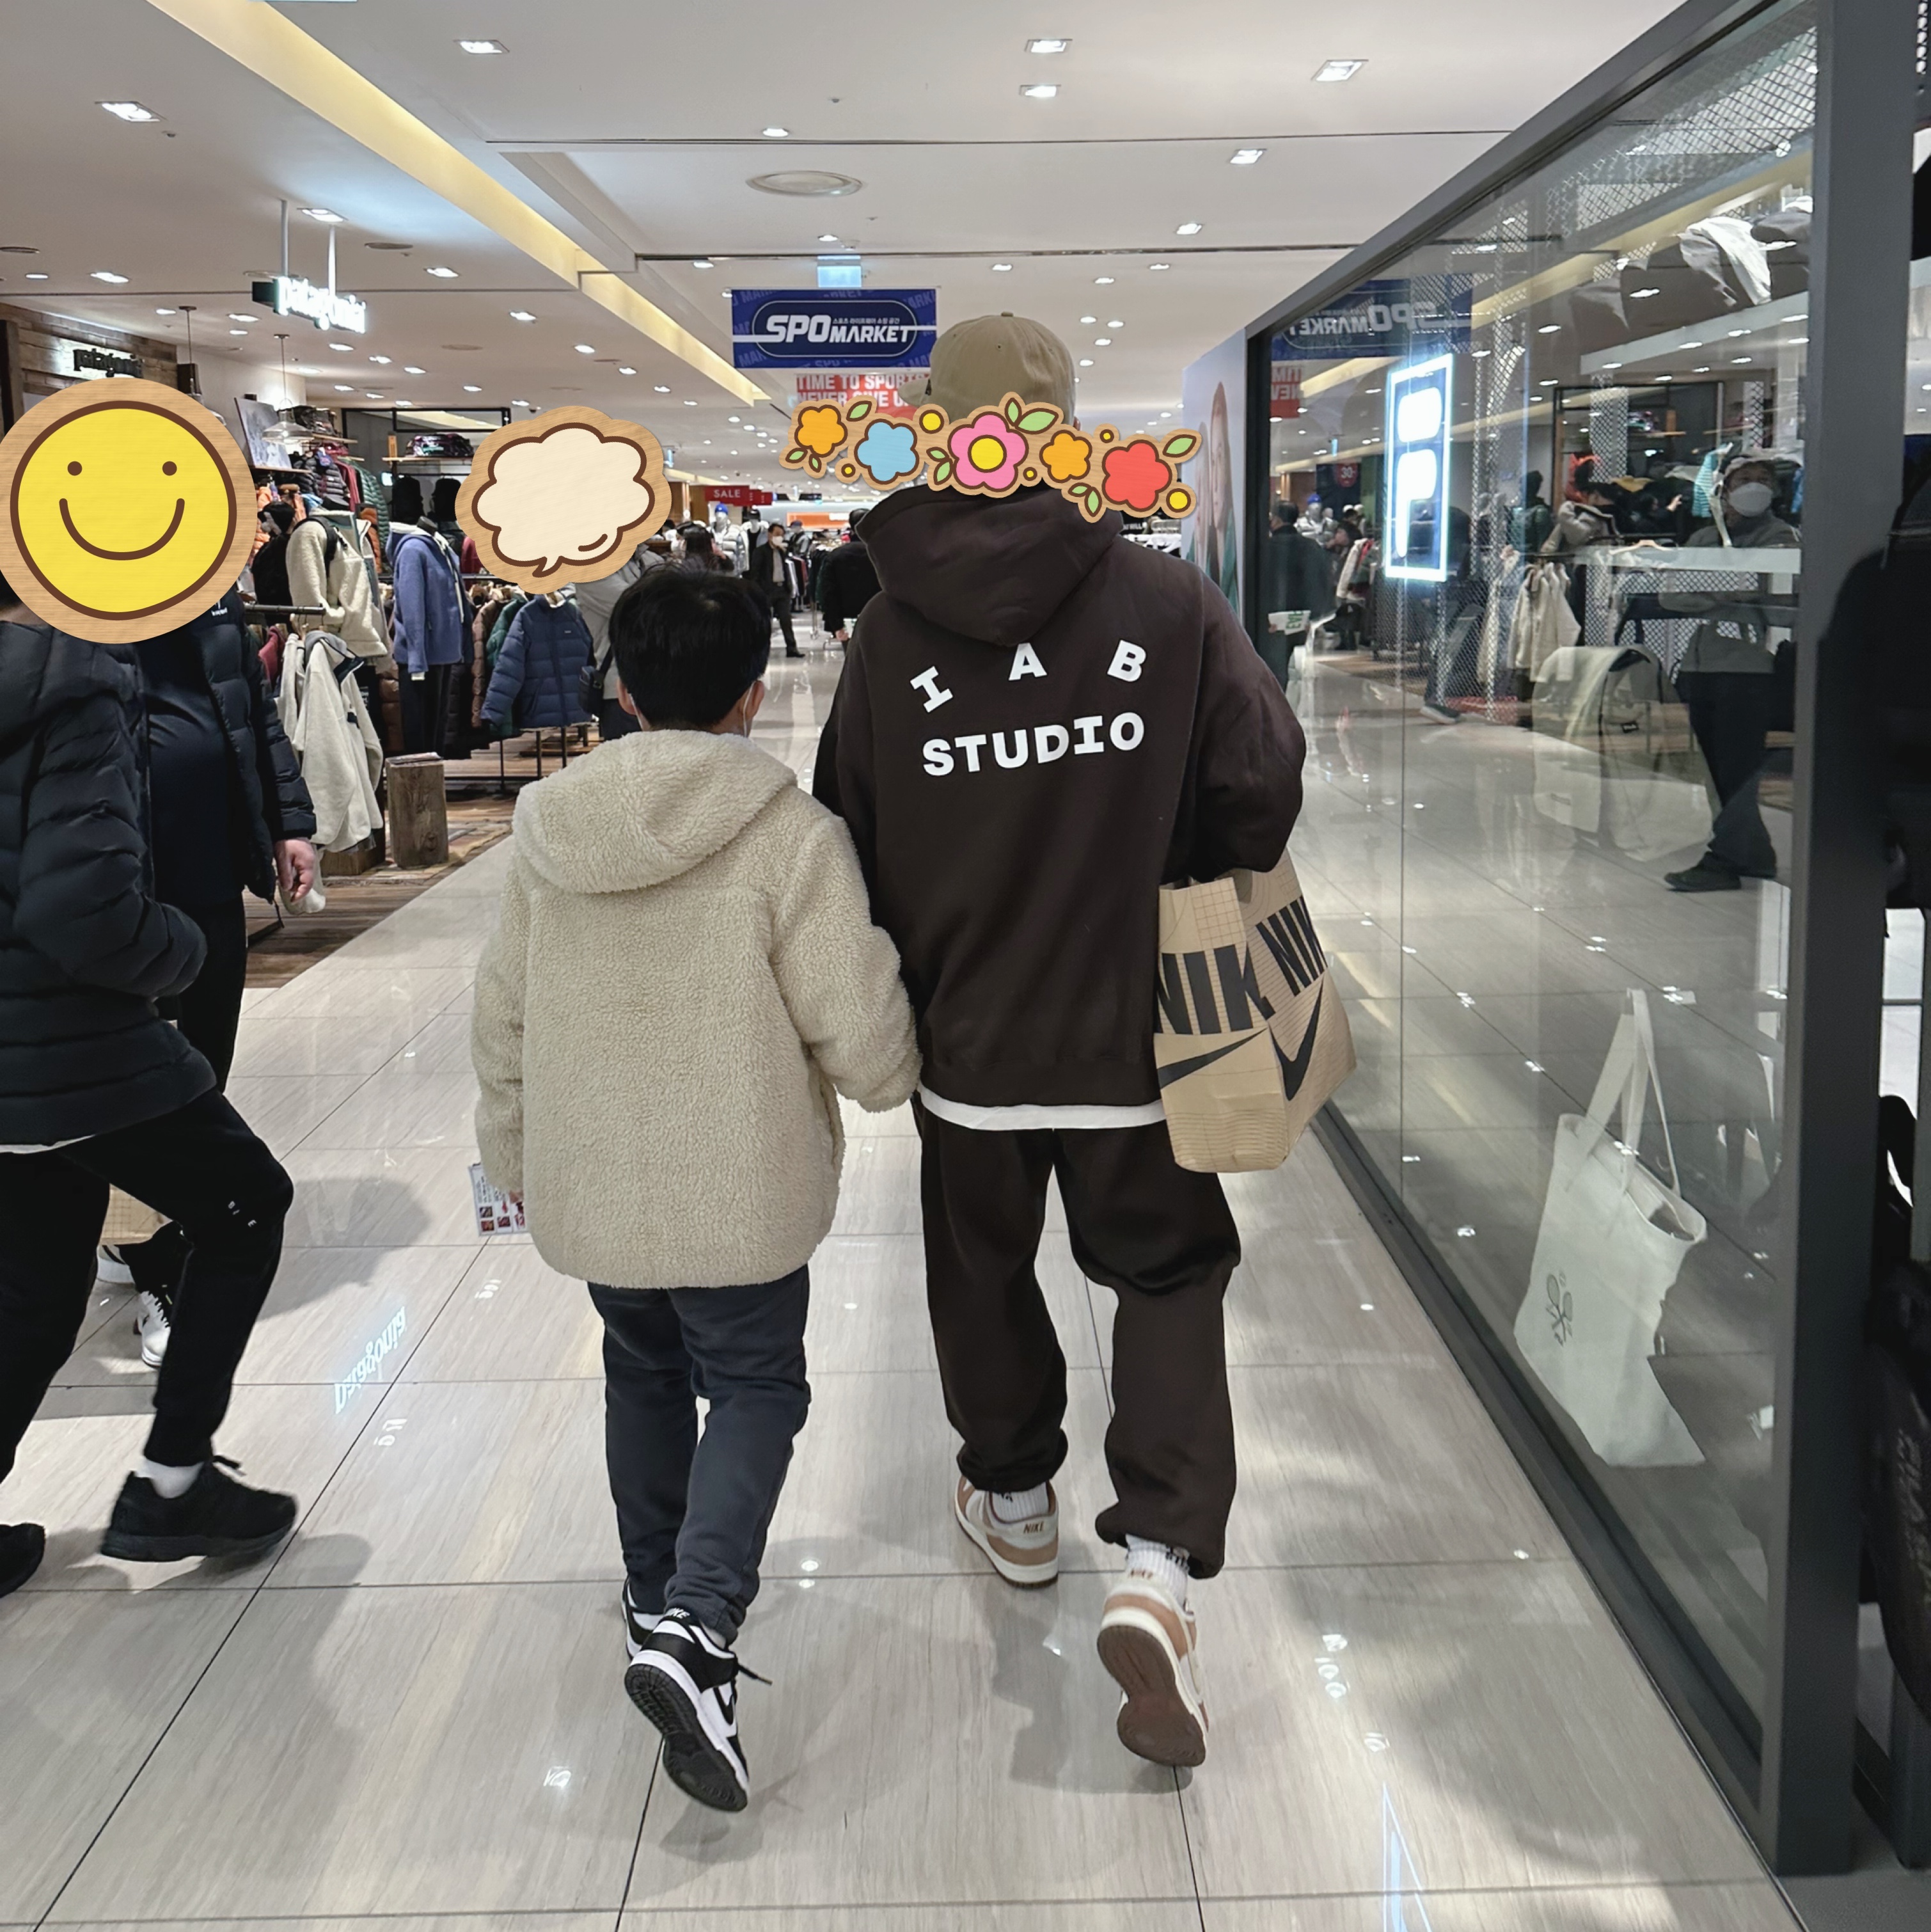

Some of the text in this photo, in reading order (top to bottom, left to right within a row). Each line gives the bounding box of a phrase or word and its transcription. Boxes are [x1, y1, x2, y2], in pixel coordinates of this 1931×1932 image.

[766, 315, 832, 343] SPO
[829, 325, 910, 343] MARKET
[798, 374, 931, 390] TIME TO SPOR
[713, 489, 741, 498] SALE
[922, 711, 1145, 777] STUDIO
[1023, 1521, 1044, 1534] NIKE
